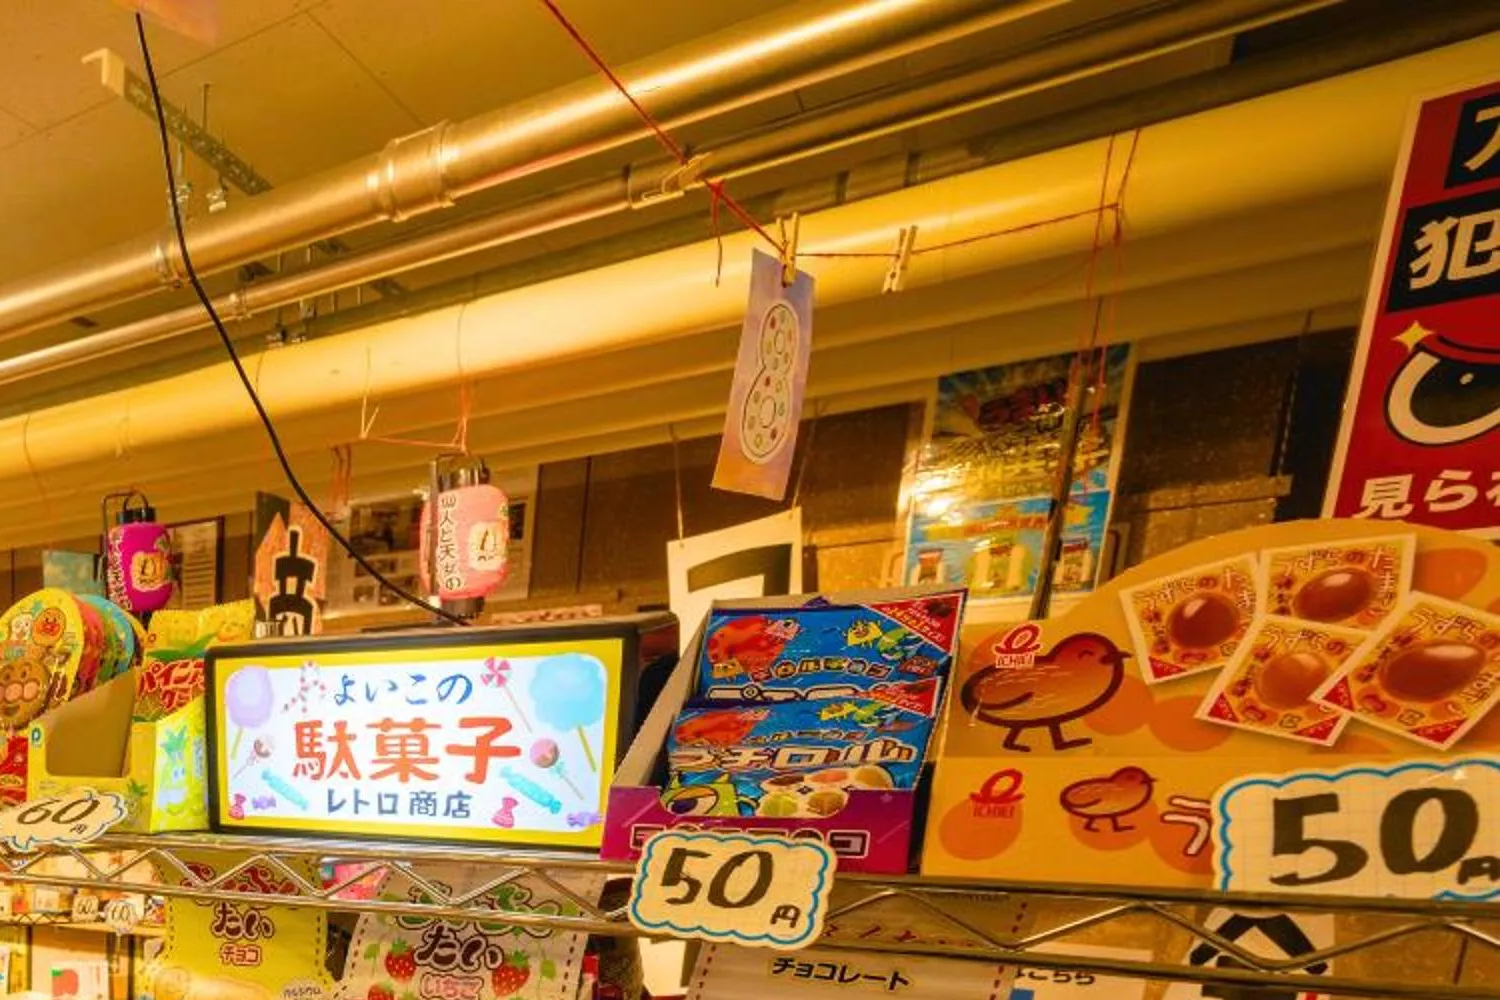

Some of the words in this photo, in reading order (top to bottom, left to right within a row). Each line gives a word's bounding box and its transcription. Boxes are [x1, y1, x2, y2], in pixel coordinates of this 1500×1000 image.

[333, 672, 474, 706] よいこの
[291, 716, 522, 785] 駄菓子
[16, 798, 102, 835] 60円
[326, 788, 473, 820] レトロ商店
[1269, 787, 1500, 886] 50円
[660, 847, 801, 929] 50円
[212, 901, 275, 939] たい
[221, 944, 262, 966] チョコ
[413, 922, 504, 973] たい
[772, 956, 910, 991] チョコレート
